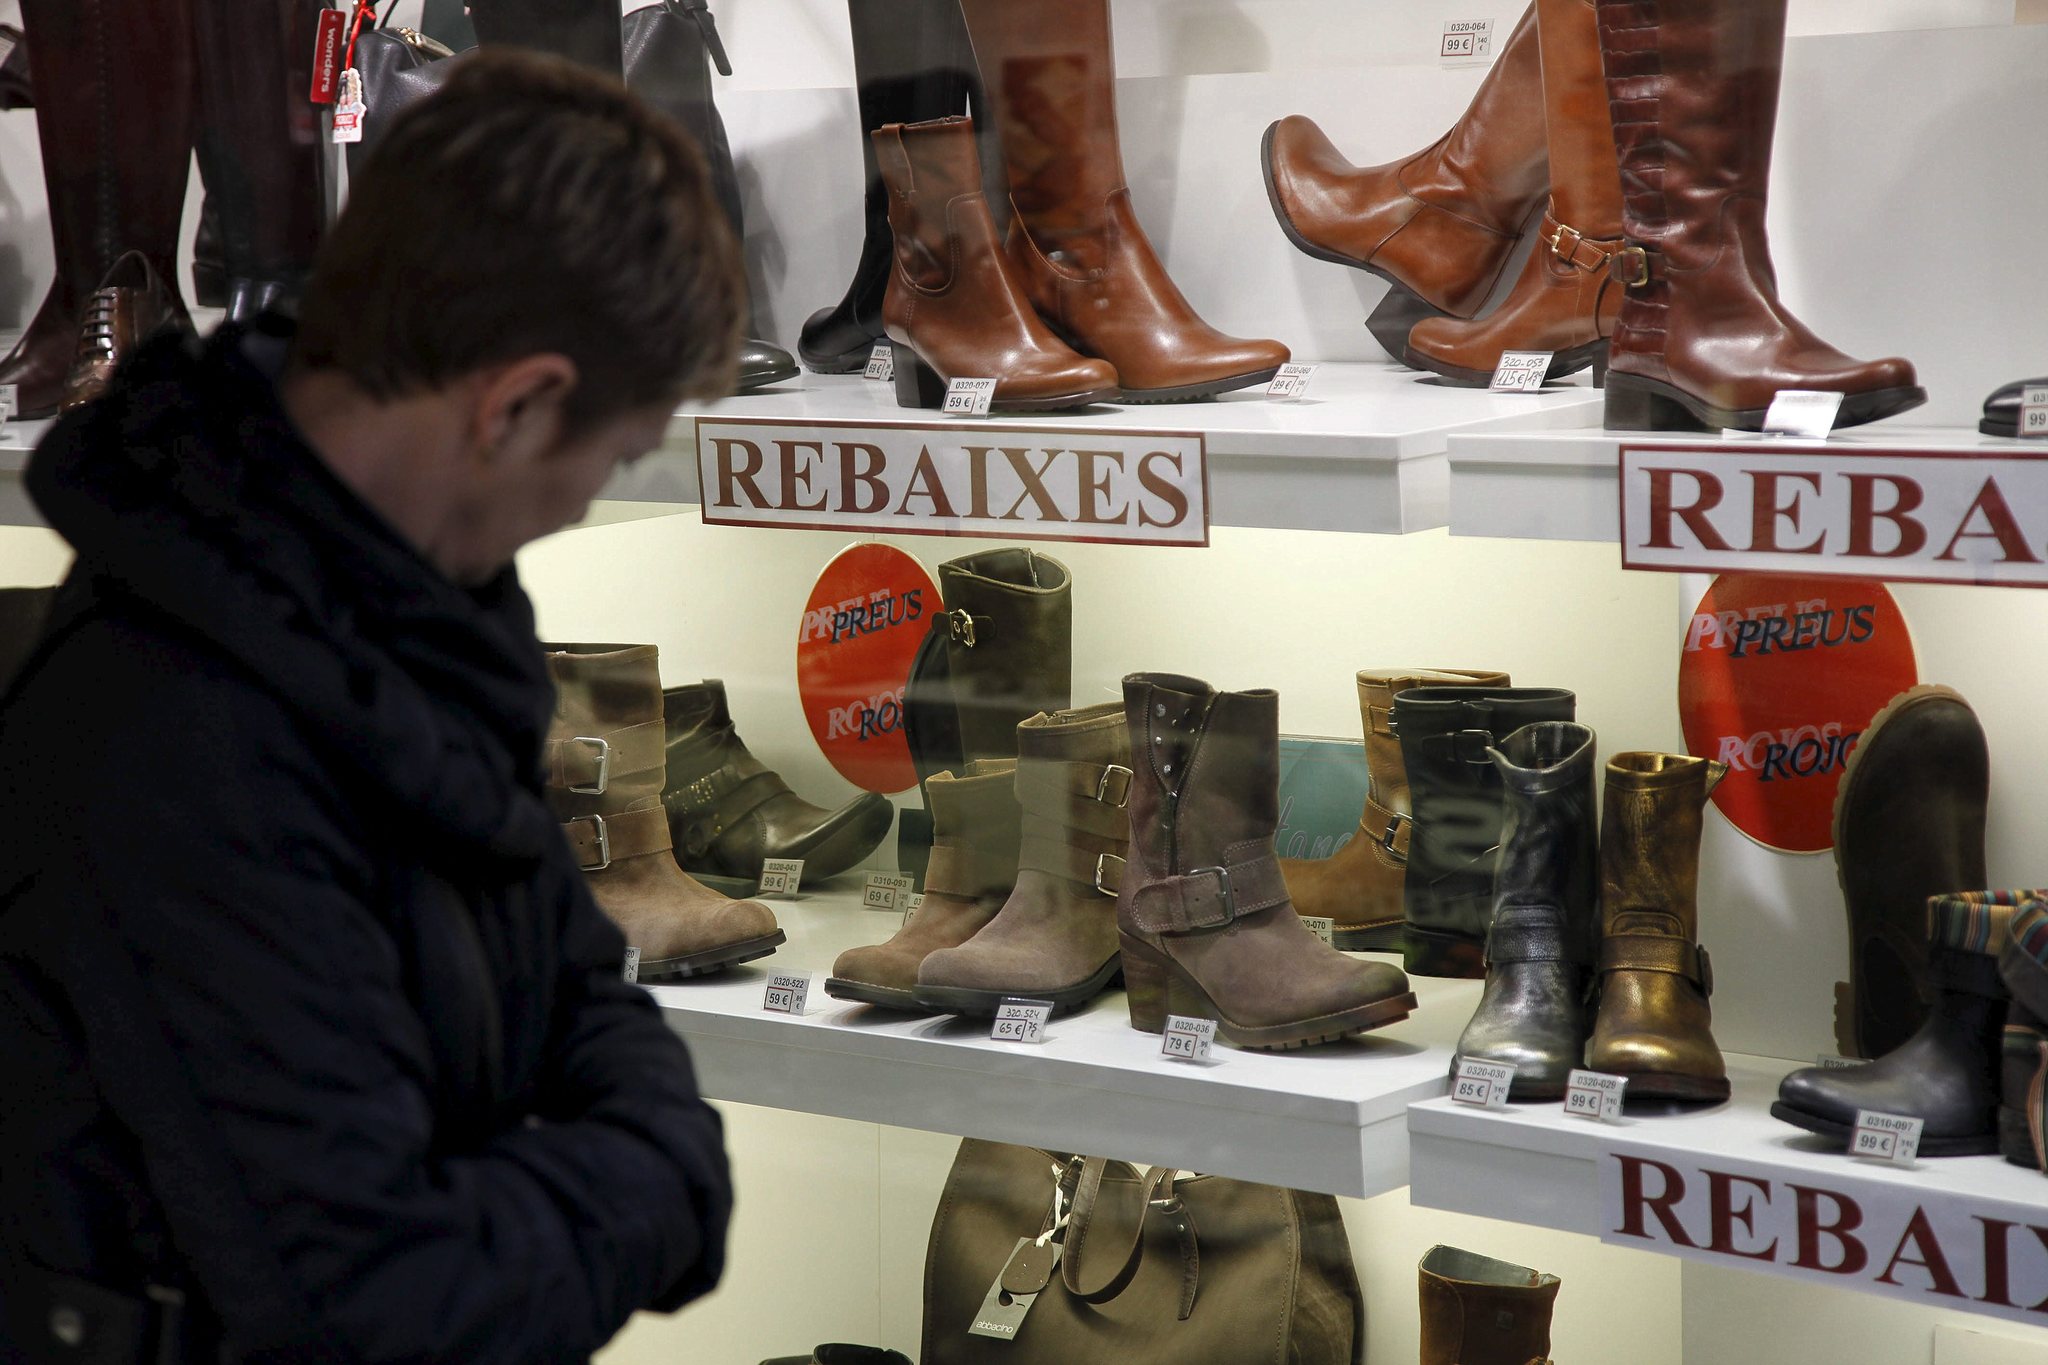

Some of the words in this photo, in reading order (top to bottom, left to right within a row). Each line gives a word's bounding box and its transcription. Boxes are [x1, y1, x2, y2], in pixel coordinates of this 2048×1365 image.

[1451, 22, 1486, 31] 0320-064
[1447, 39, 1460, 50] 99
[1462, 38, 1470, 50] €
[321, 27, 336, 92] wonders
[1503, 357, 1545, 368] 320-053
[955, 381, 990, 390] 0320-027
[949, 397, 962, 407] 59
[964, 397, 971, 408] €
[2030, 413, 2047, 426] 99
[708, 437, 1189, 528] REBAIXES
[829, 588, 923, 644] PREUS
[1729, 604, 1876, 658] PREUS
[764, 877, 775, 887] 99
[873, 876, 907, 888] 0310-093
[869, 890, 881, 901] 69
[884, 892, 891, 903] €
[773, 976, 804, 988] 0320-522
[769, 993, 780, 1004] 59
[782, 994, 789, 1005] €
[999, 1022, 1012, 1034] 65
[1175, 1020, 1210, 1034] 0320-036
[1169, 1037, 1182, 1050] 79
[1184, 1040, 1192, 1051] €
[1466, 1065, 1507, 1080] 0320-030
[1577, 1076, 1617, 1090] 0320-029
[1459, 1082, 1474, 1096] 85
[1476, 1084, 1485, 1098] €
[1571, 1094, 1586, 1107] 99
[1867, 1115, 1915, 1132] 0310-097
[1860, 1134, 1878, 1149] 99
